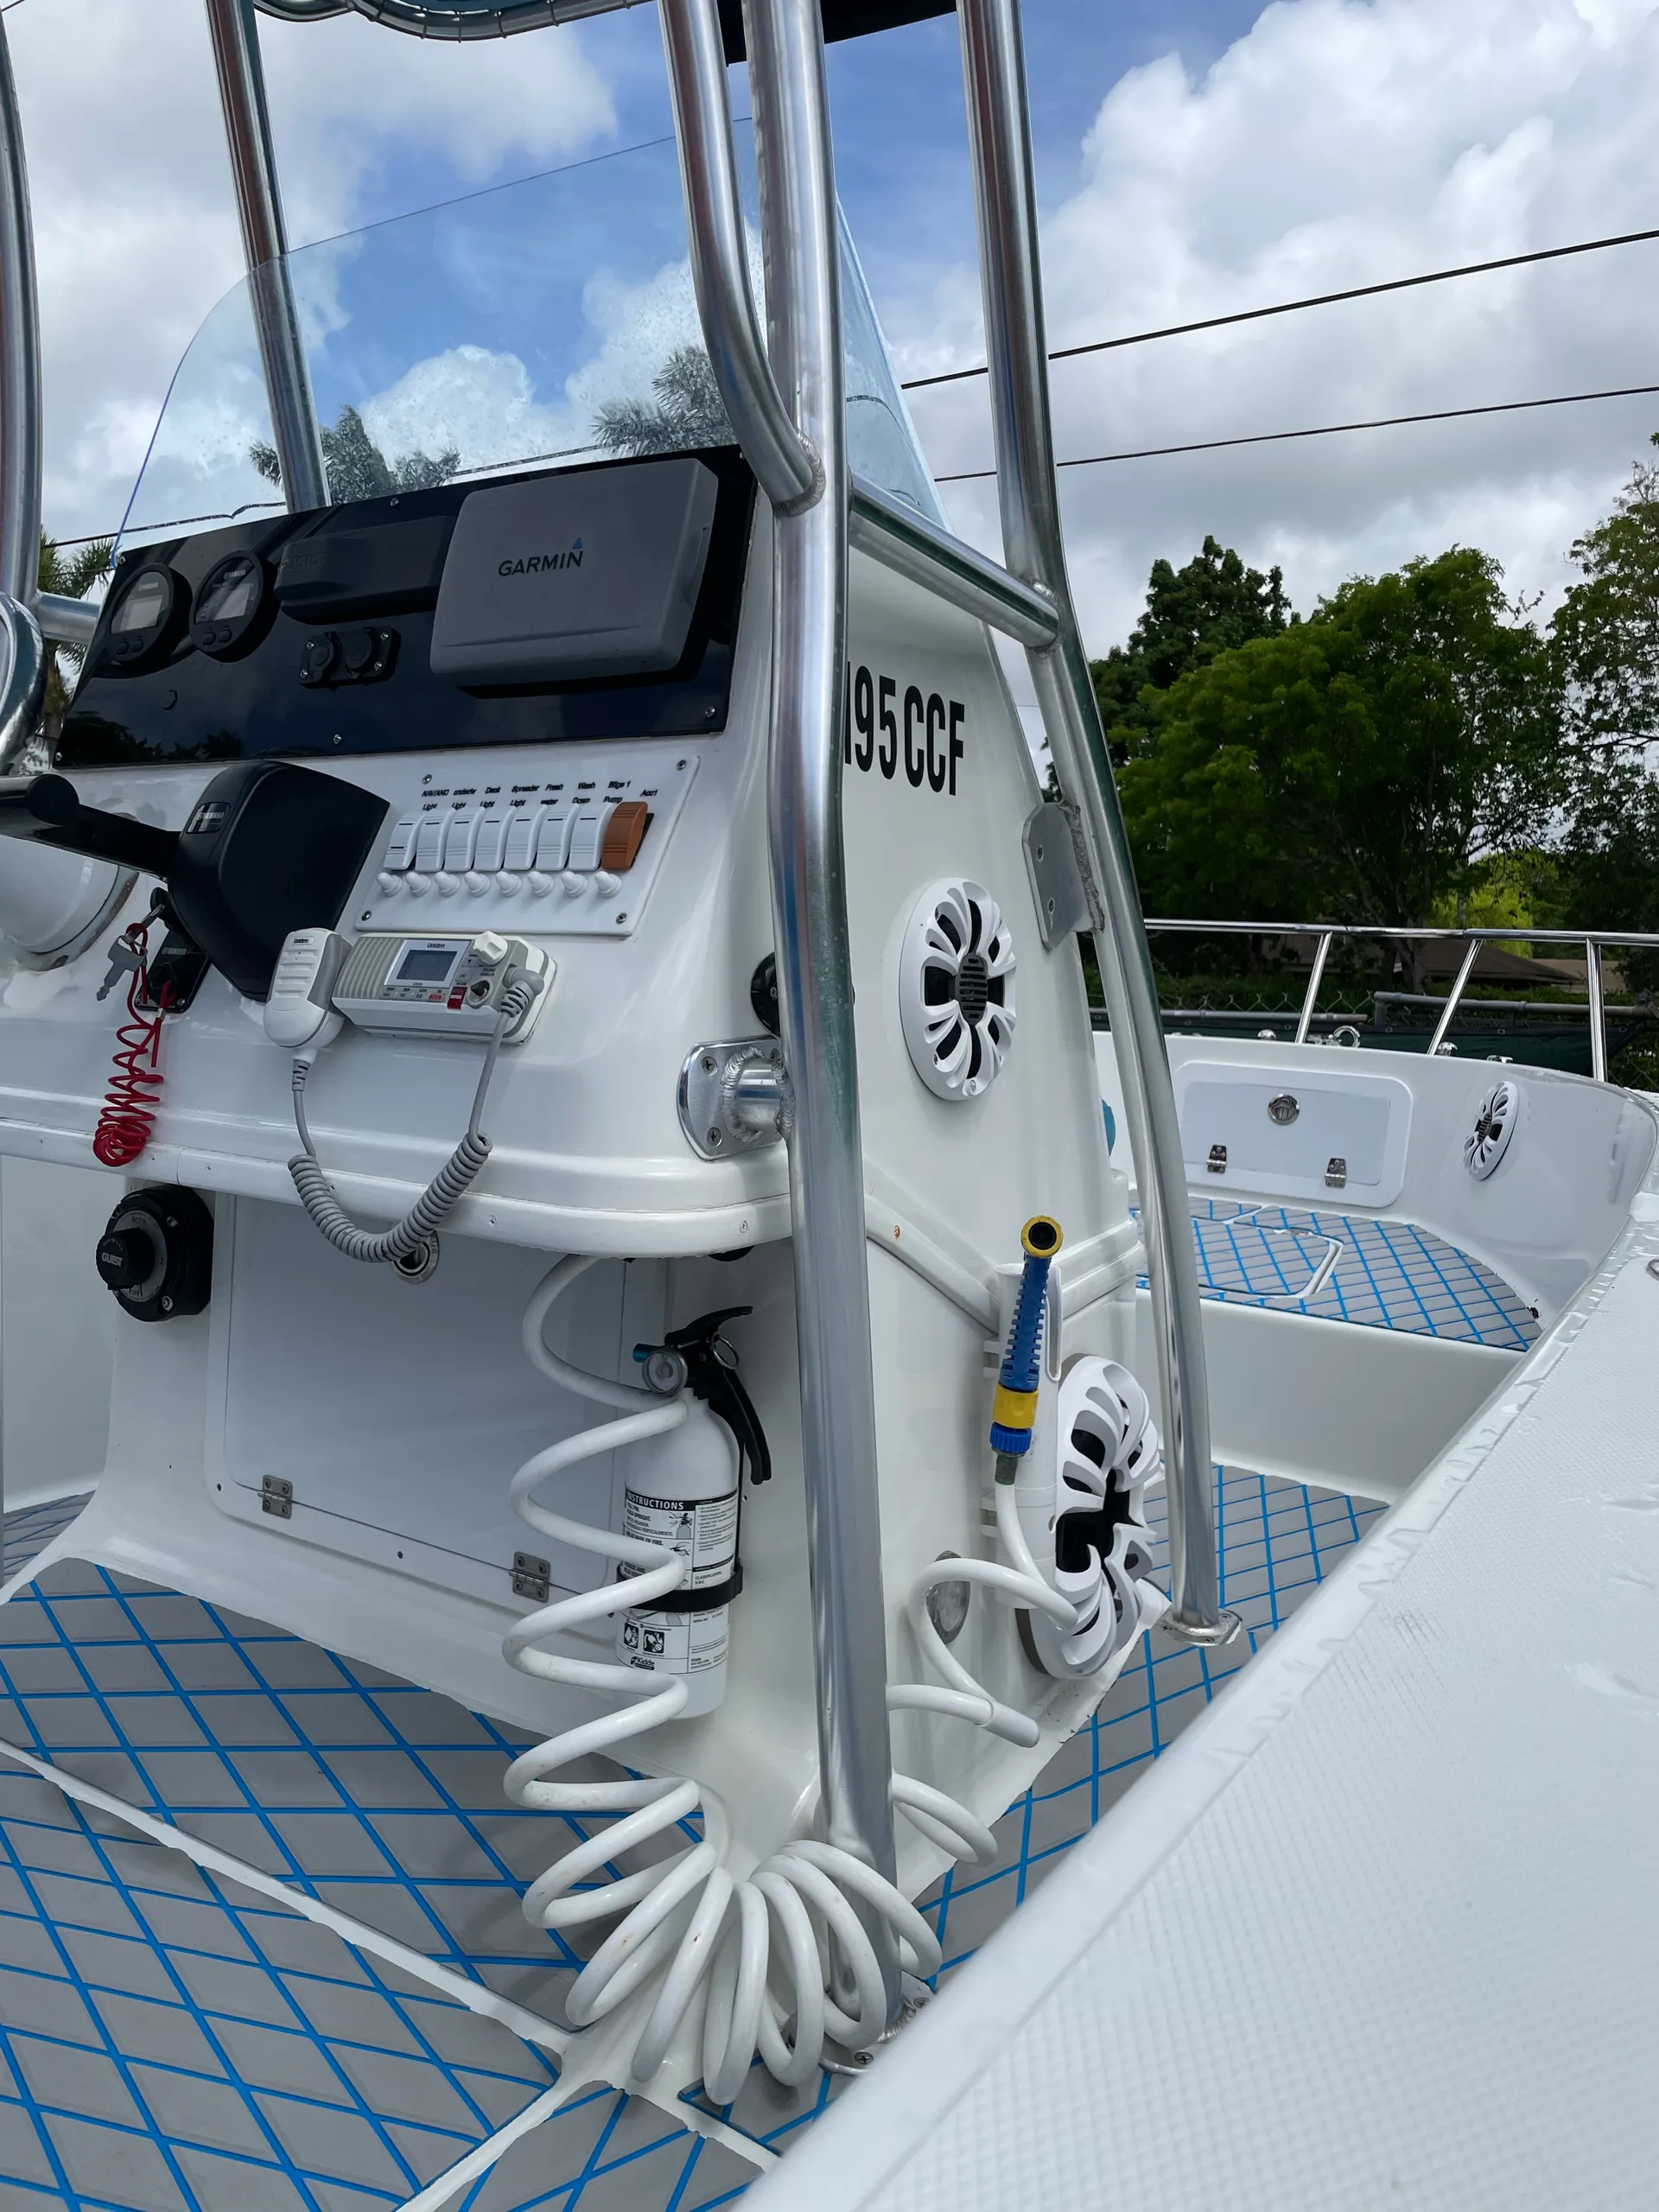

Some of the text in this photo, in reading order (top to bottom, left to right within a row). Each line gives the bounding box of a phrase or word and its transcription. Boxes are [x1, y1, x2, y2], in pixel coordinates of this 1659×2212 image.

[498, 550, 583, 577] GARMIN
[452, 802, 467, 810] Light
[509, 799, 526, 808] Light
[131, 1216, 147, 1225] BOTH
[101, 1252, 124, 1267] GUEST
[627, 1490, 684, 1510] STRUCTIONS
[637, 1657, 655, 1666] Kidde
